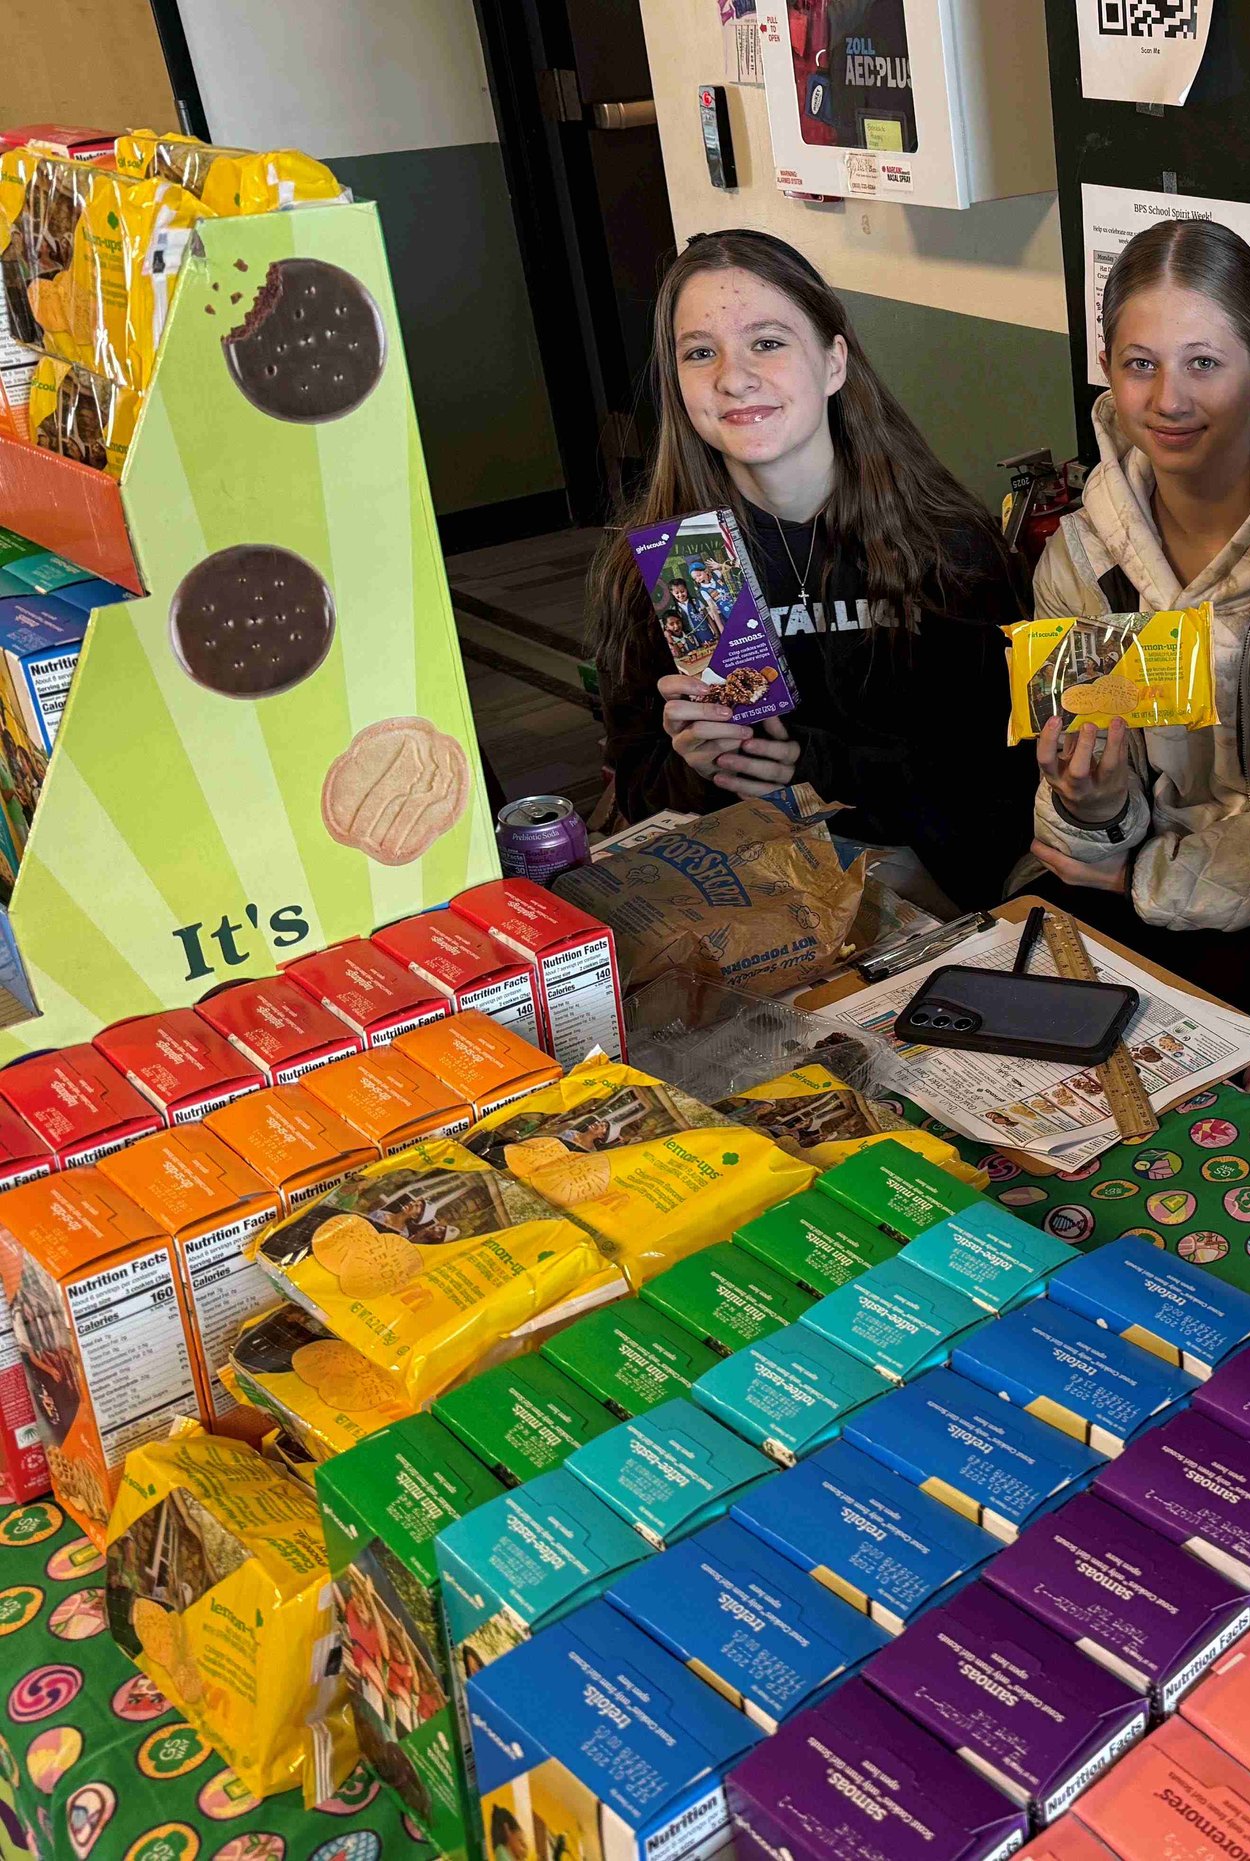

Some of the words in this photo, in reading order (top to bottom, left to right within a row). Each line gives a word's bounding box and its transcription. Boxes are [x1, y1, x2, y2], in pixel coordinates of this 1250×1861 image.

[846, 38, 875, 54] ZOLL
[1134, 204, 1148, 214] BPS
[1148, 205, 1170, 216] School
[1097, 254, 1114, 262] Monday
[636, 542, 646, 554] girl
[646, 539, 668, 550] scouts
[728, 631, 763, 647] samoas
[512, 832, 542, 842] Prebiotic
[542, 830, 560, 840] Soda
[172, 903, 310, 982] It's
[543, 949, 582, 970] Nutrition
[584, 940, 608, 956] Facts
[792, 936, 818, 952] NOT
[720, 944, 788, 976] POPCORN
[461, 984, 502, 1006] Nutrition
[503, 974, 529, 990] Facts
[548, 984, 576, 998] Calories
[596, 968, 612, 980] 140
[516, 1004, 533, 1017] 140
[372, 1022, 416, 1044] Nutrition
[418, 1010, 445, 1027] Facts
[278, 1060, 326, 1084] Nutrition
[175, 1100, 226, 1124] Nutrition
[67, 1144, 122, 1168] Nutrition
[14, 1168, 48, 1188] Facts
[290, 1176, 342, 1205] Nutrition
[886, 1177, 914, 1198] mints
[913, 1195, 934, 1211] thin
[185, 1226, 240, 1254] Nutrition
[243, 1208, 276, 1230] Facts
[806, 1232, 836, 1254] mints
[836, 1249, 854, 1266] thin
[68, 1270, 128, 1300] Nutrition
[131, 1252, 167, 1275] Facts
[192, 1266, 231, 1288] Calories
[716, 1286, 748, 1308] mints
[1146, 1278, 1187, 1306] trefoils
[77, 1310, 119, 1335] Calories
[150, 1286, 174, 1303] 160
[747, 1304, 766, 1320] thin
[620, 1344, 652, 1370] mints
[1053, 1346, 1098, 1376] trefoils
[651, 1368, 670, 1385] thin
[513, 1404, 545, 1432] mints
[544, 1430, 562, 1448] thin
[948, 1422, 994, 1454] trefoils
[397, 1465, 427, 1502] mints
[1185, 1466, 1242, 1504] samoas
[425, 1500, 444, 1522] thin
[842, 1506, 888, 1541] trefoils
[1077, 1558, 1134, 1602] samoas
[718, 1592, 766, 1632] trefoils
[1165, 1646, 1216, 1700] Nutrition
[1219, 1613, 1250, 1648] Facts
[959, 1661, 1019, 1708] samoas
[584, 1684, 631, 1728] trefoils
[1048, 1754, 1106, 1816] Nutrition
[1108, 1720, 1143, 1758] Facts
[828, 1768, 888, 1822] samoas
[646, 1795, 718, 1855] Nutrition
